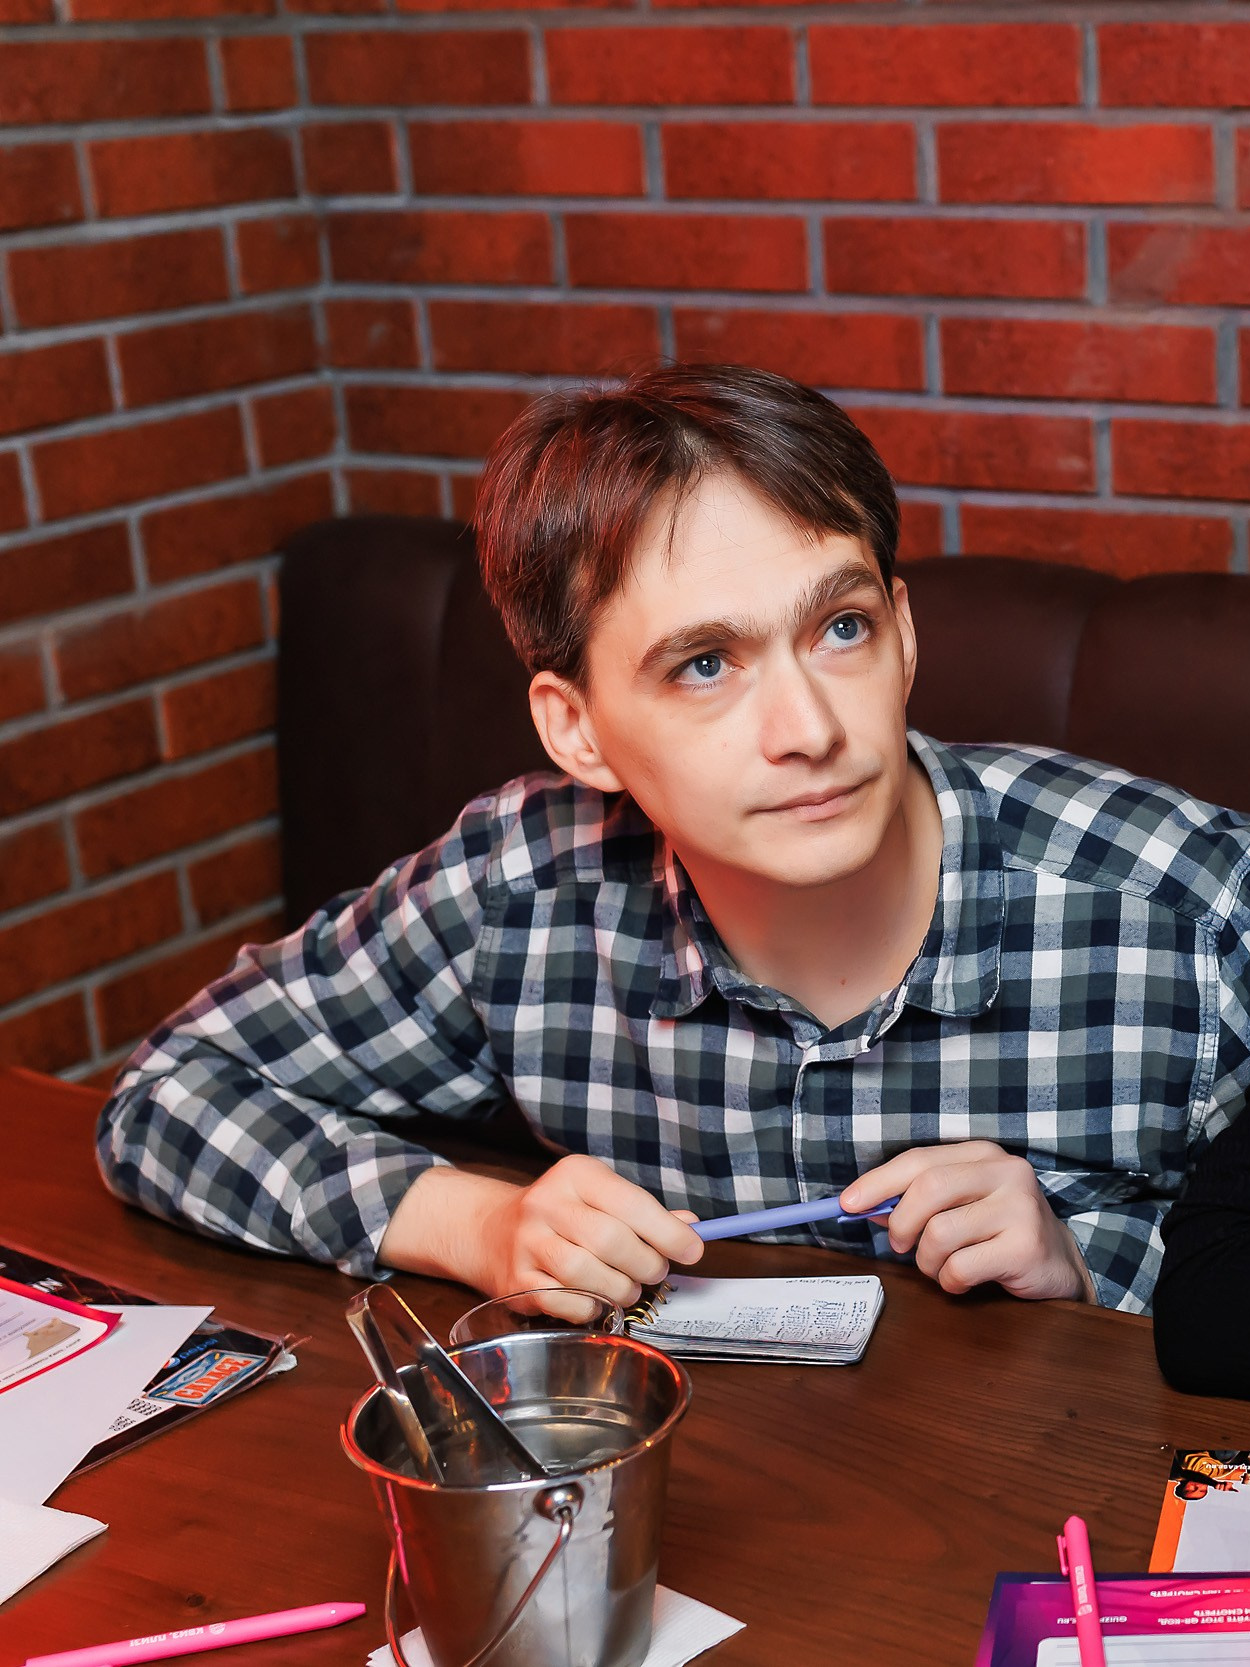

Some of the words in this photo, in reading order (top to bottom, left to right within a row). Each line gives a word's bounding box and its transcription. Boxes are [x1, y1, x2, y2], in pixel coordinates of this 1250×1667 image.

[174, 1357, 253, 1400] GARAGE
[1193, 1608, 1244, 1617] СМОТРЕТЬ
[1200, 1616, 1225, 1624] ЭТОТ
[168, 1627, 204, 1639] КВИЗ,
[130, 1634, 167, 1647] ПЛИЗ!
